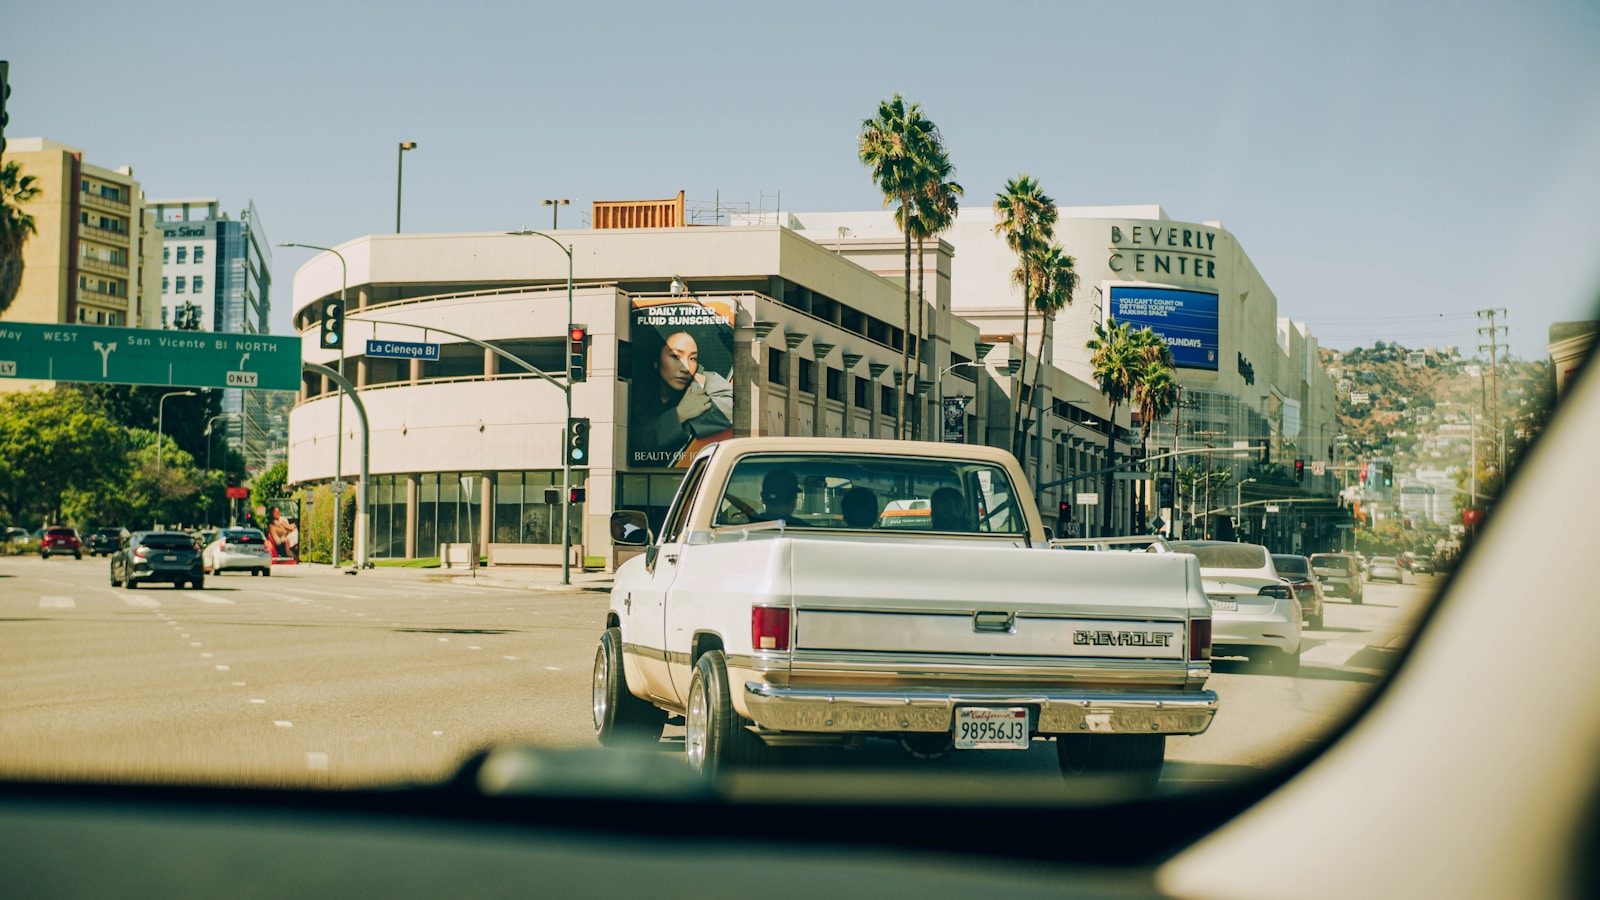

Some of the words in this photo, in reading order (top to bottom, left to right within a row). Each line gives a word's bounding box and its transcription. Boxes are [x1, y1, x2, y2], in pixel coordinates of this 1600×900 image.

[179, 225, 205, 237] Sinai
[1111, 225, 1215, 250] BEVERLY
[1108, 253, 1215, 279] CENTER
[648, 307, 677, 316] DAILY
[679, 307, 715, 316] TINTED
[637, 316, 667, 325] FLUID
[668, 316, 730, 325] SUNSCREEN
[0, 329, 22, 341] Way
[44, 331, 78, 342] WEST
[128, 335, 151, 346] San
[159, 337, 206, 349] Vicente
[236, 341, 277, 353] NORTH
[1167, 337, 1202, 348] SUNDAYS
[370, 343, 382, 352] La
[384, 343, 423, 357] Cienega
[425, 346, 435, 356] Bl
[1, 364, 14, 373] LY
[228, 374, 256, 383] ONLY
[634, 451, 671, 461] BEAUTY
[673, 451, 686, 461] OF
[1073, 630, 1174, 647] CHEVROLET
[971, 710, 1011, 721] California
[961, 722, 1023, 740] 98956J3
